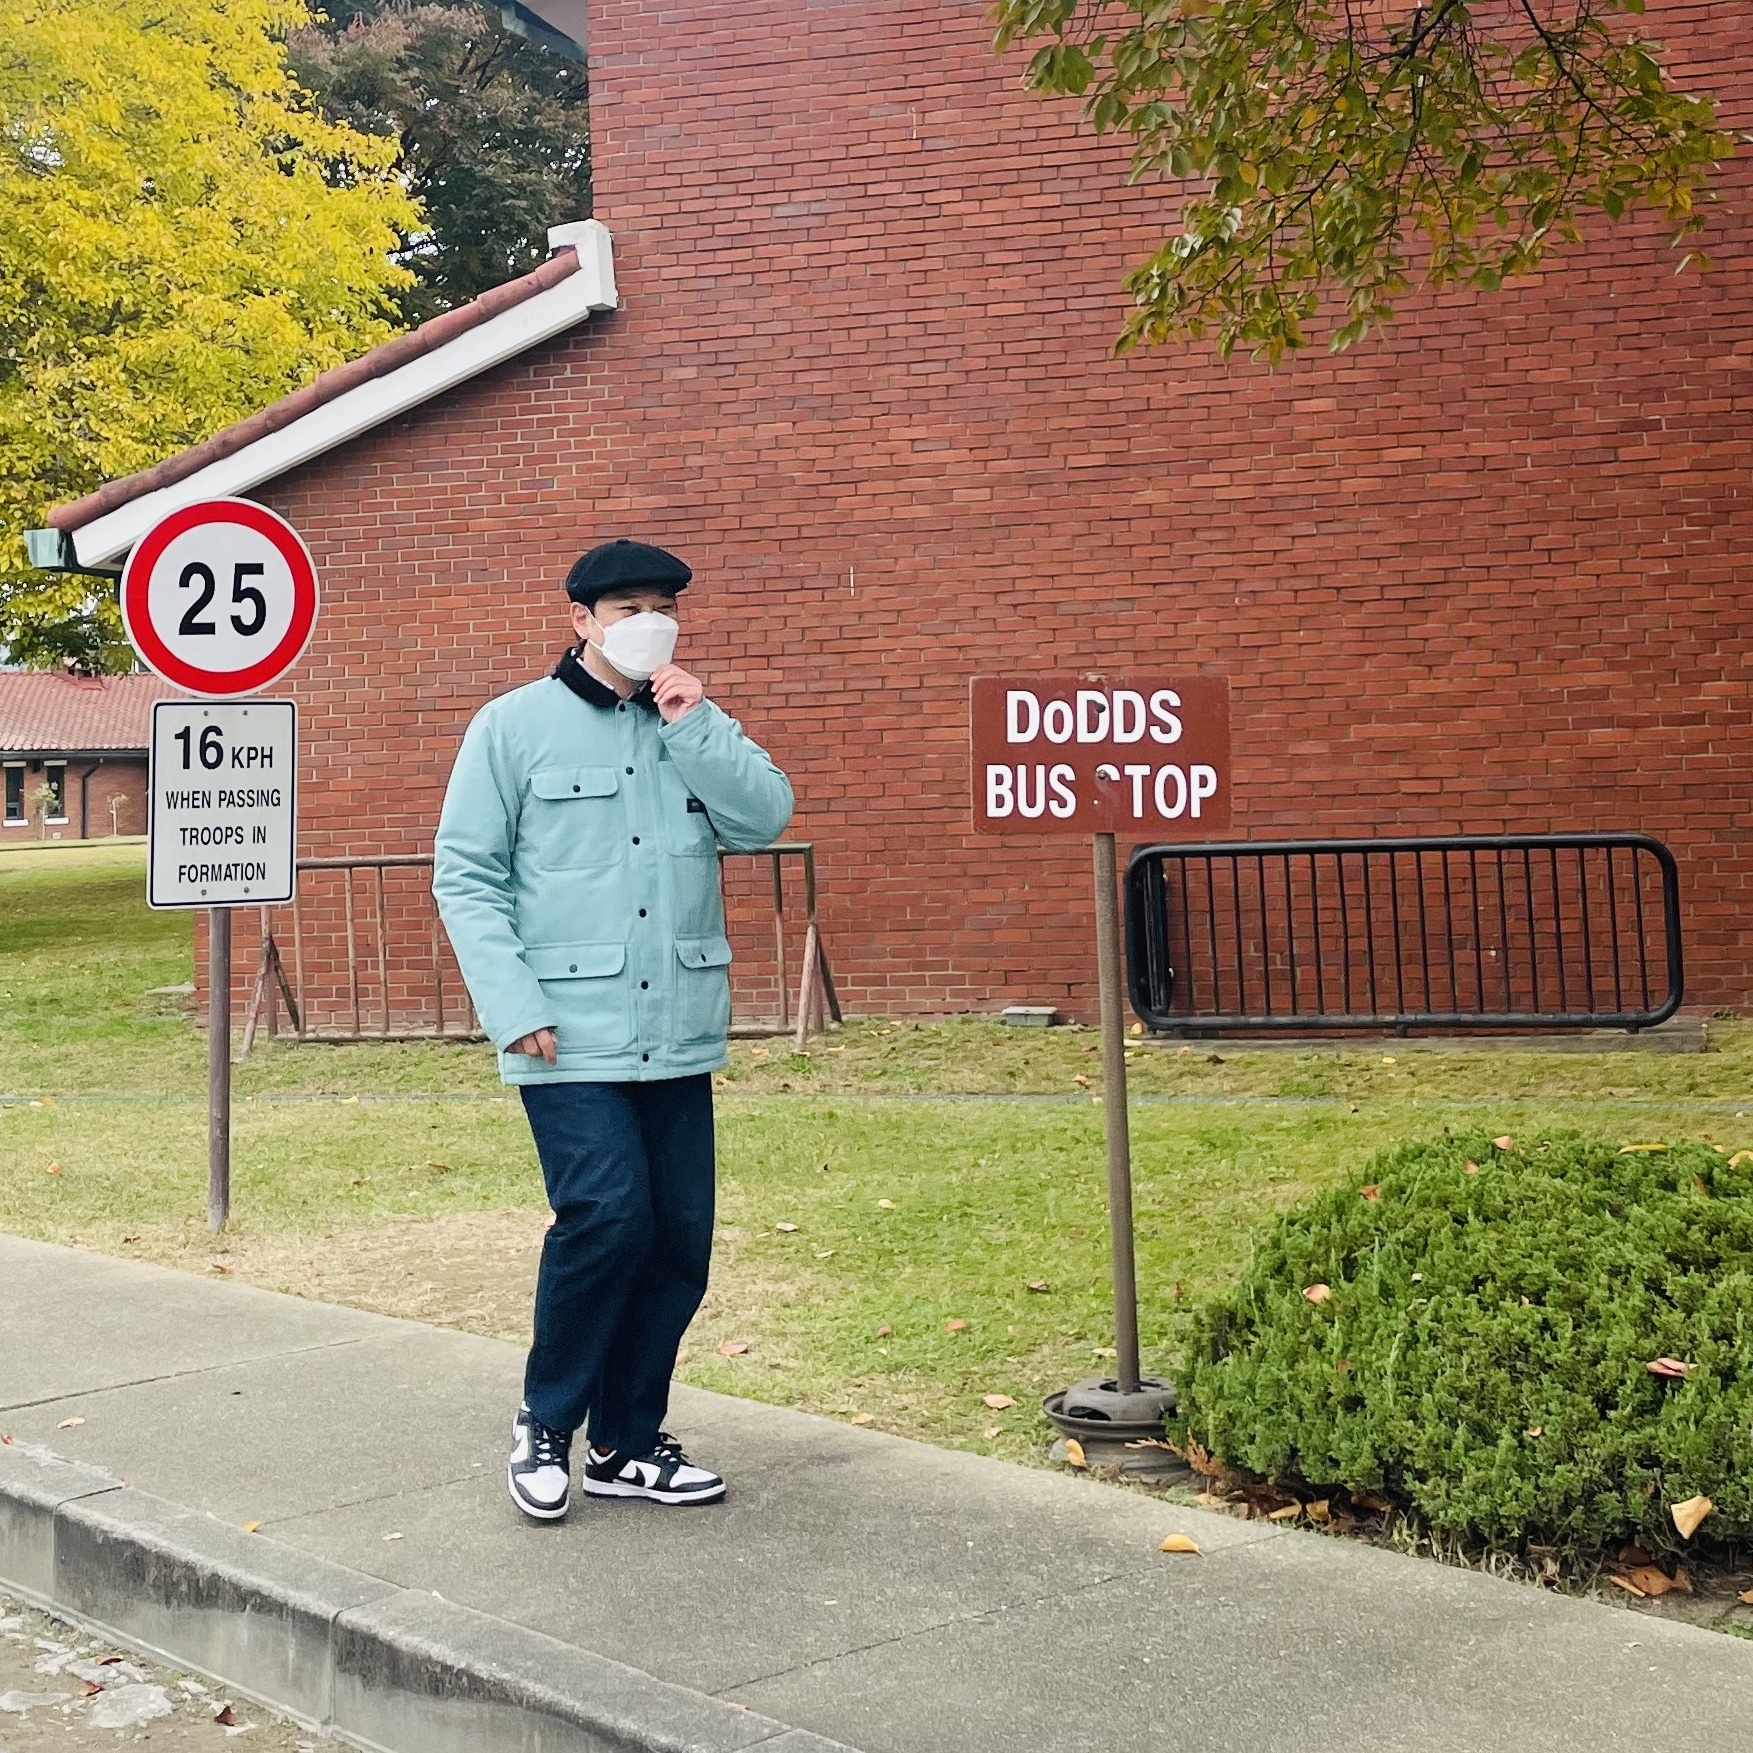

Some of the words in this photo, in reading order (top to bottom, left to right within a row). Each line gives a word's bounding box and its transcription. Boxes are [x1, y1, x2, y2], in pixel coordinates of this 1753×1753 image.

[179, 562, 266, 636] 25
[1006, 689, 1182, 744] DoDDS
[174, 725, 224, 769] 16
[231, 746, 273, 769] KPH
[166, 790, 211, 809] WHEN
[218, 788, 281, 808] PASSING
[985, 763, 1077, 819] BUS
[180, 826, 244, 846] TROOPS
[252, 825, 267, 844] IN
[178, 862, 266, 883] FORMATION
